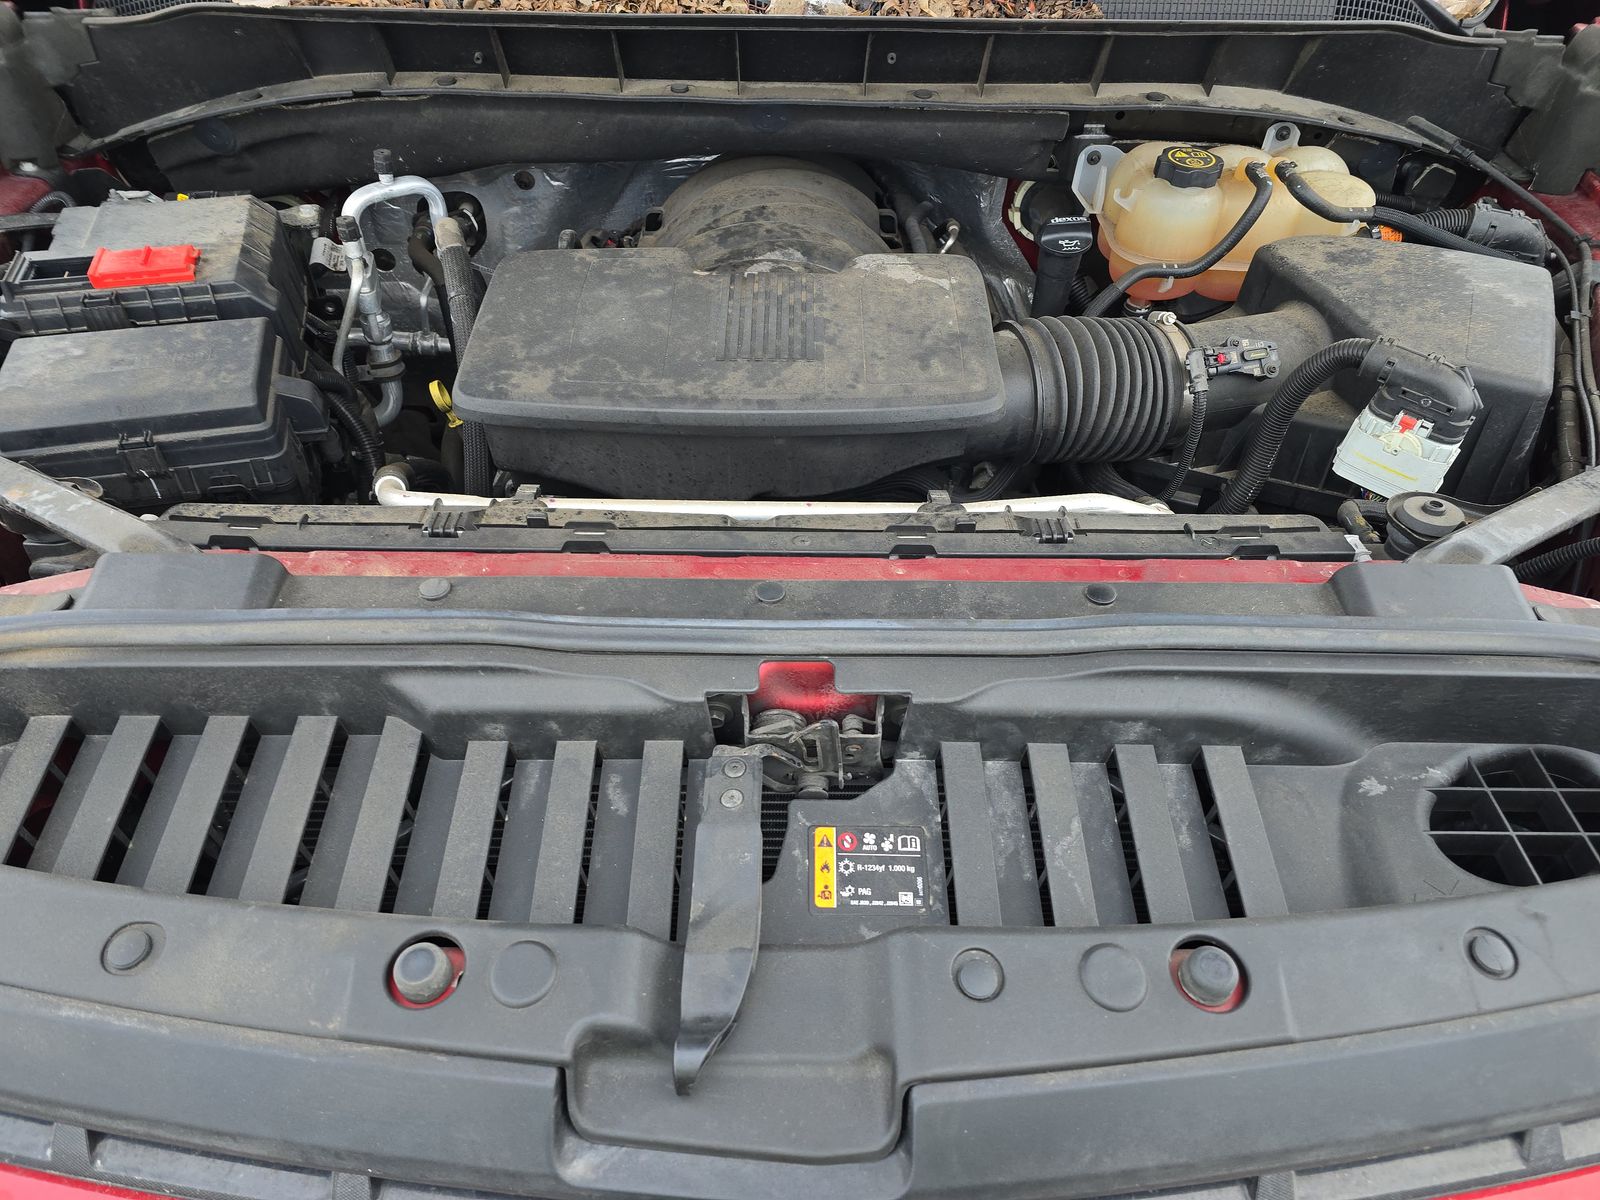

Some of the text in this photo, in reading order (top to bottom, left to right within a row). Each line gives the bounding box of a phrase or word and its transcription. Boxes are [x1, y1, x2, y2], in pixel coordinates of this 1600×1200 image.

[856, 864, 886, 873] R-1234yf
[906, 865, 916, 874] kg
[857, 887, 872, 896] PAG
